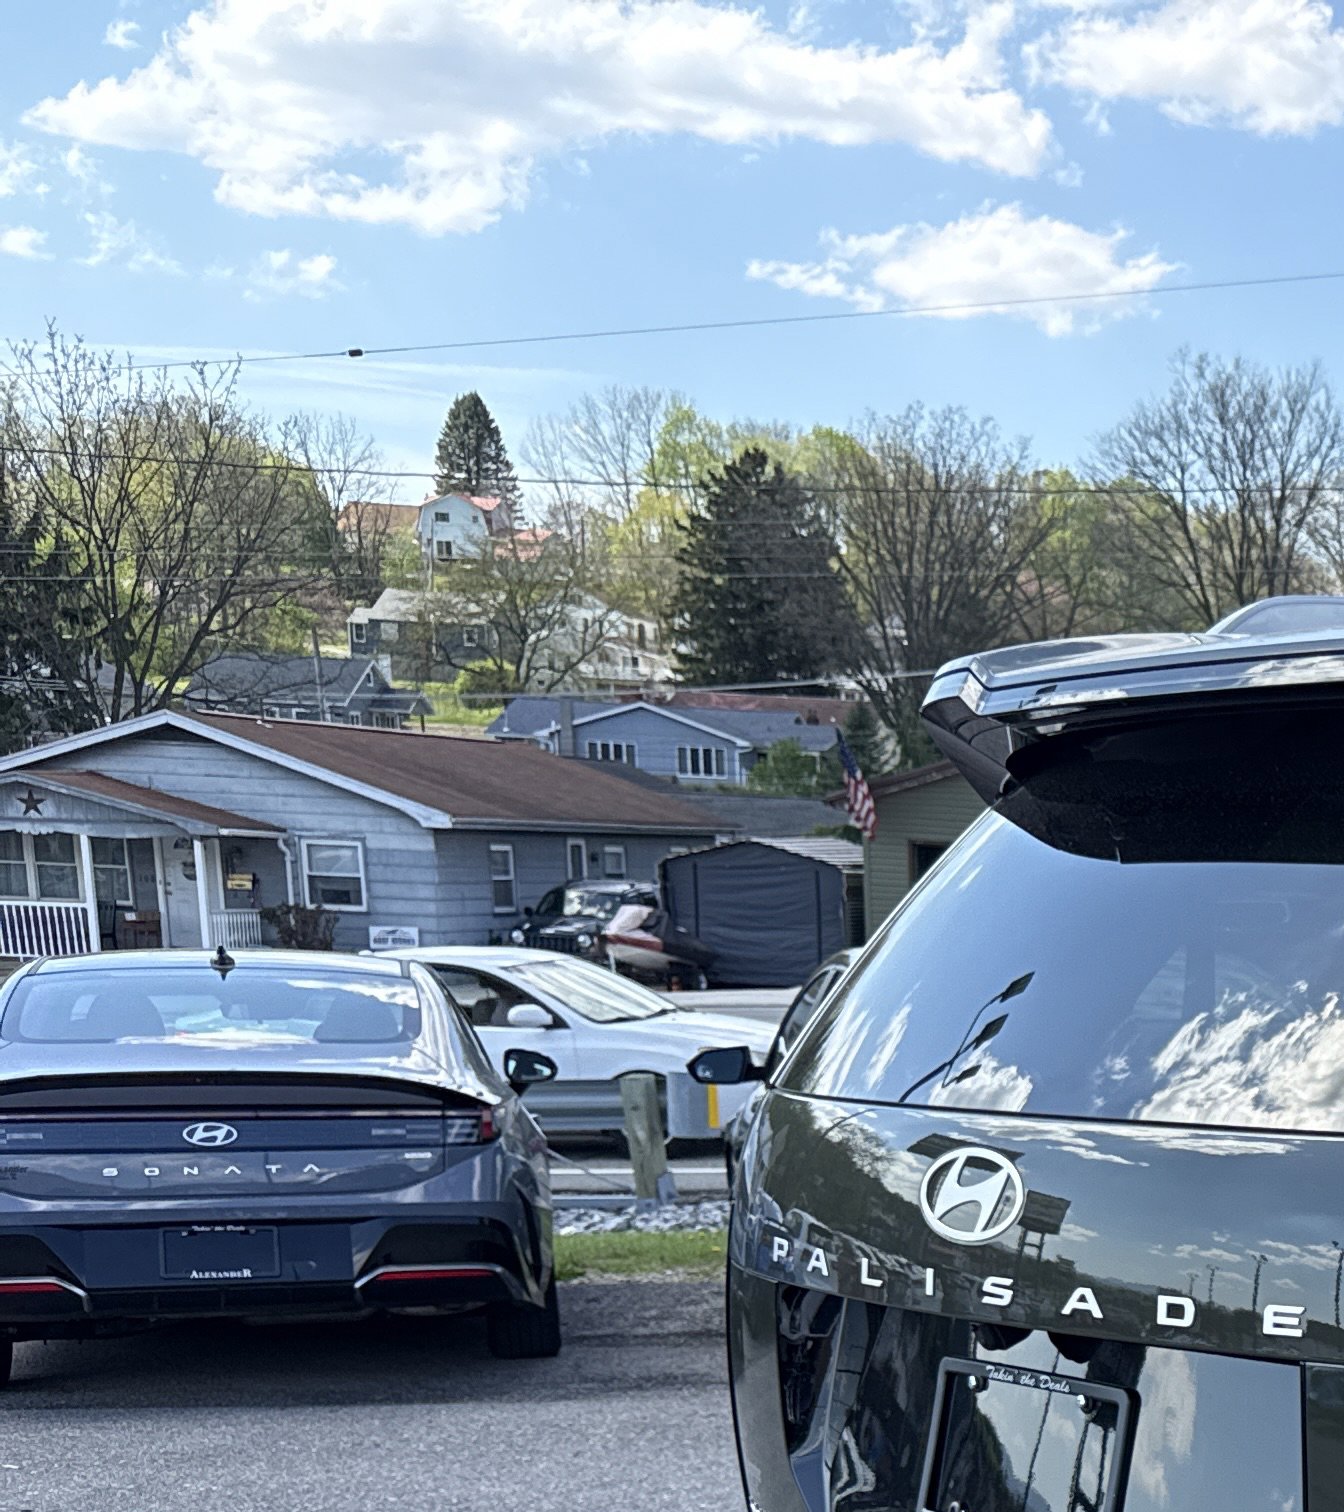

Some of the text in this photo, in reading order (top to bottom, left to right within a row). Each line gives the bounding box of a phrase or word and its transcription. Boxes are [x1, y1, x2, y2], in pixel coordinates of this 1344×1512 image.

[102, 1163, 321, 1177] SONATA
[190, 1268, 252, 1279] ALEXANDER
[771, 1234, 1307, 1339] PALISADE
